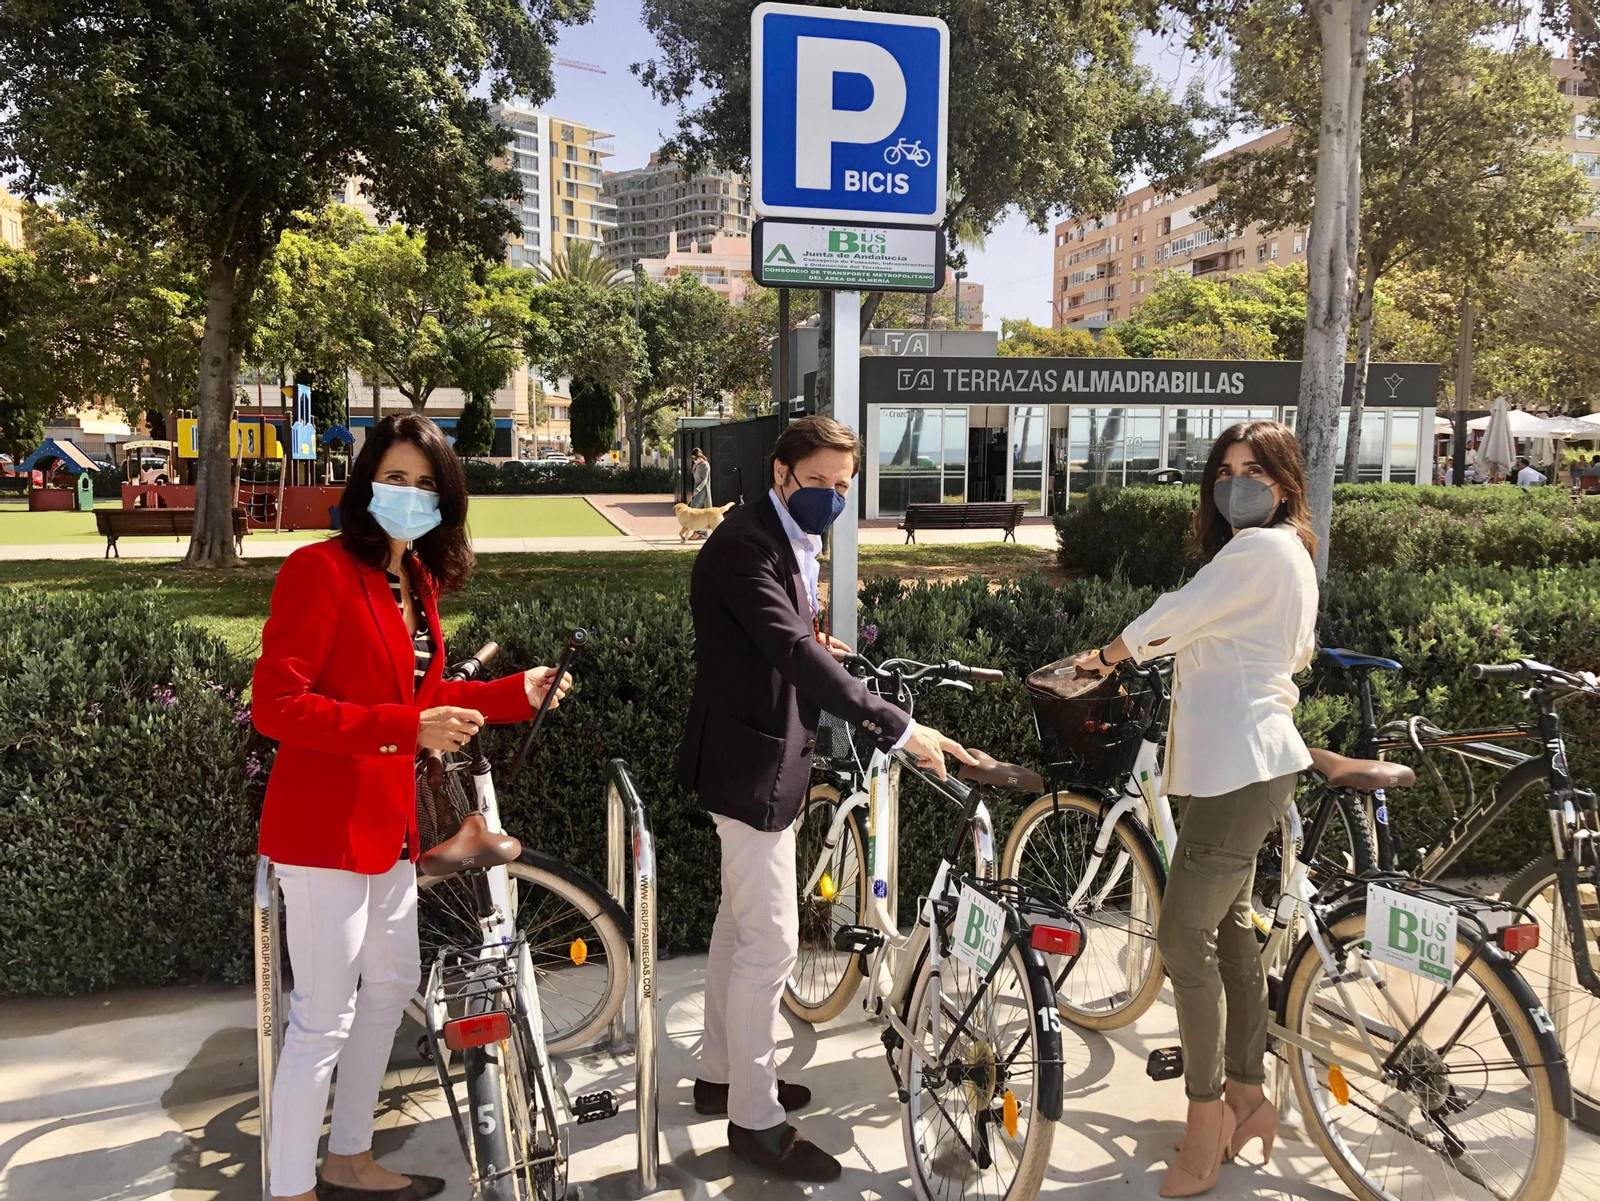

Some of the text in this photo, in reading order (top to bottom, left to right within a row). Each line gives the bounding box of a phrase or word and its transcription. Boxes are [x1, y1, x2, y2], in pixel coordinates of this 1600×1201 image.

[796, 36, 907, 190] P
[845, 170, 910, 194] BICIS
[854, 253, 907, 261] Andalucía
[872, 272, 934, 280] METROPOLITANO
[943, 368, 1057, 393] TERRAZAS
[1061, 370, 1245, 395] ALMADRABILLAS
[640, 874, 651, 999] WWW.GRUPFABREGAS.COM
[260, 907, 272, 1037] WWW.GRUPFABREGAS.COM
[1038, 1007, 1061, 1033] 15
[477, 1104, 496, 1136] 5
